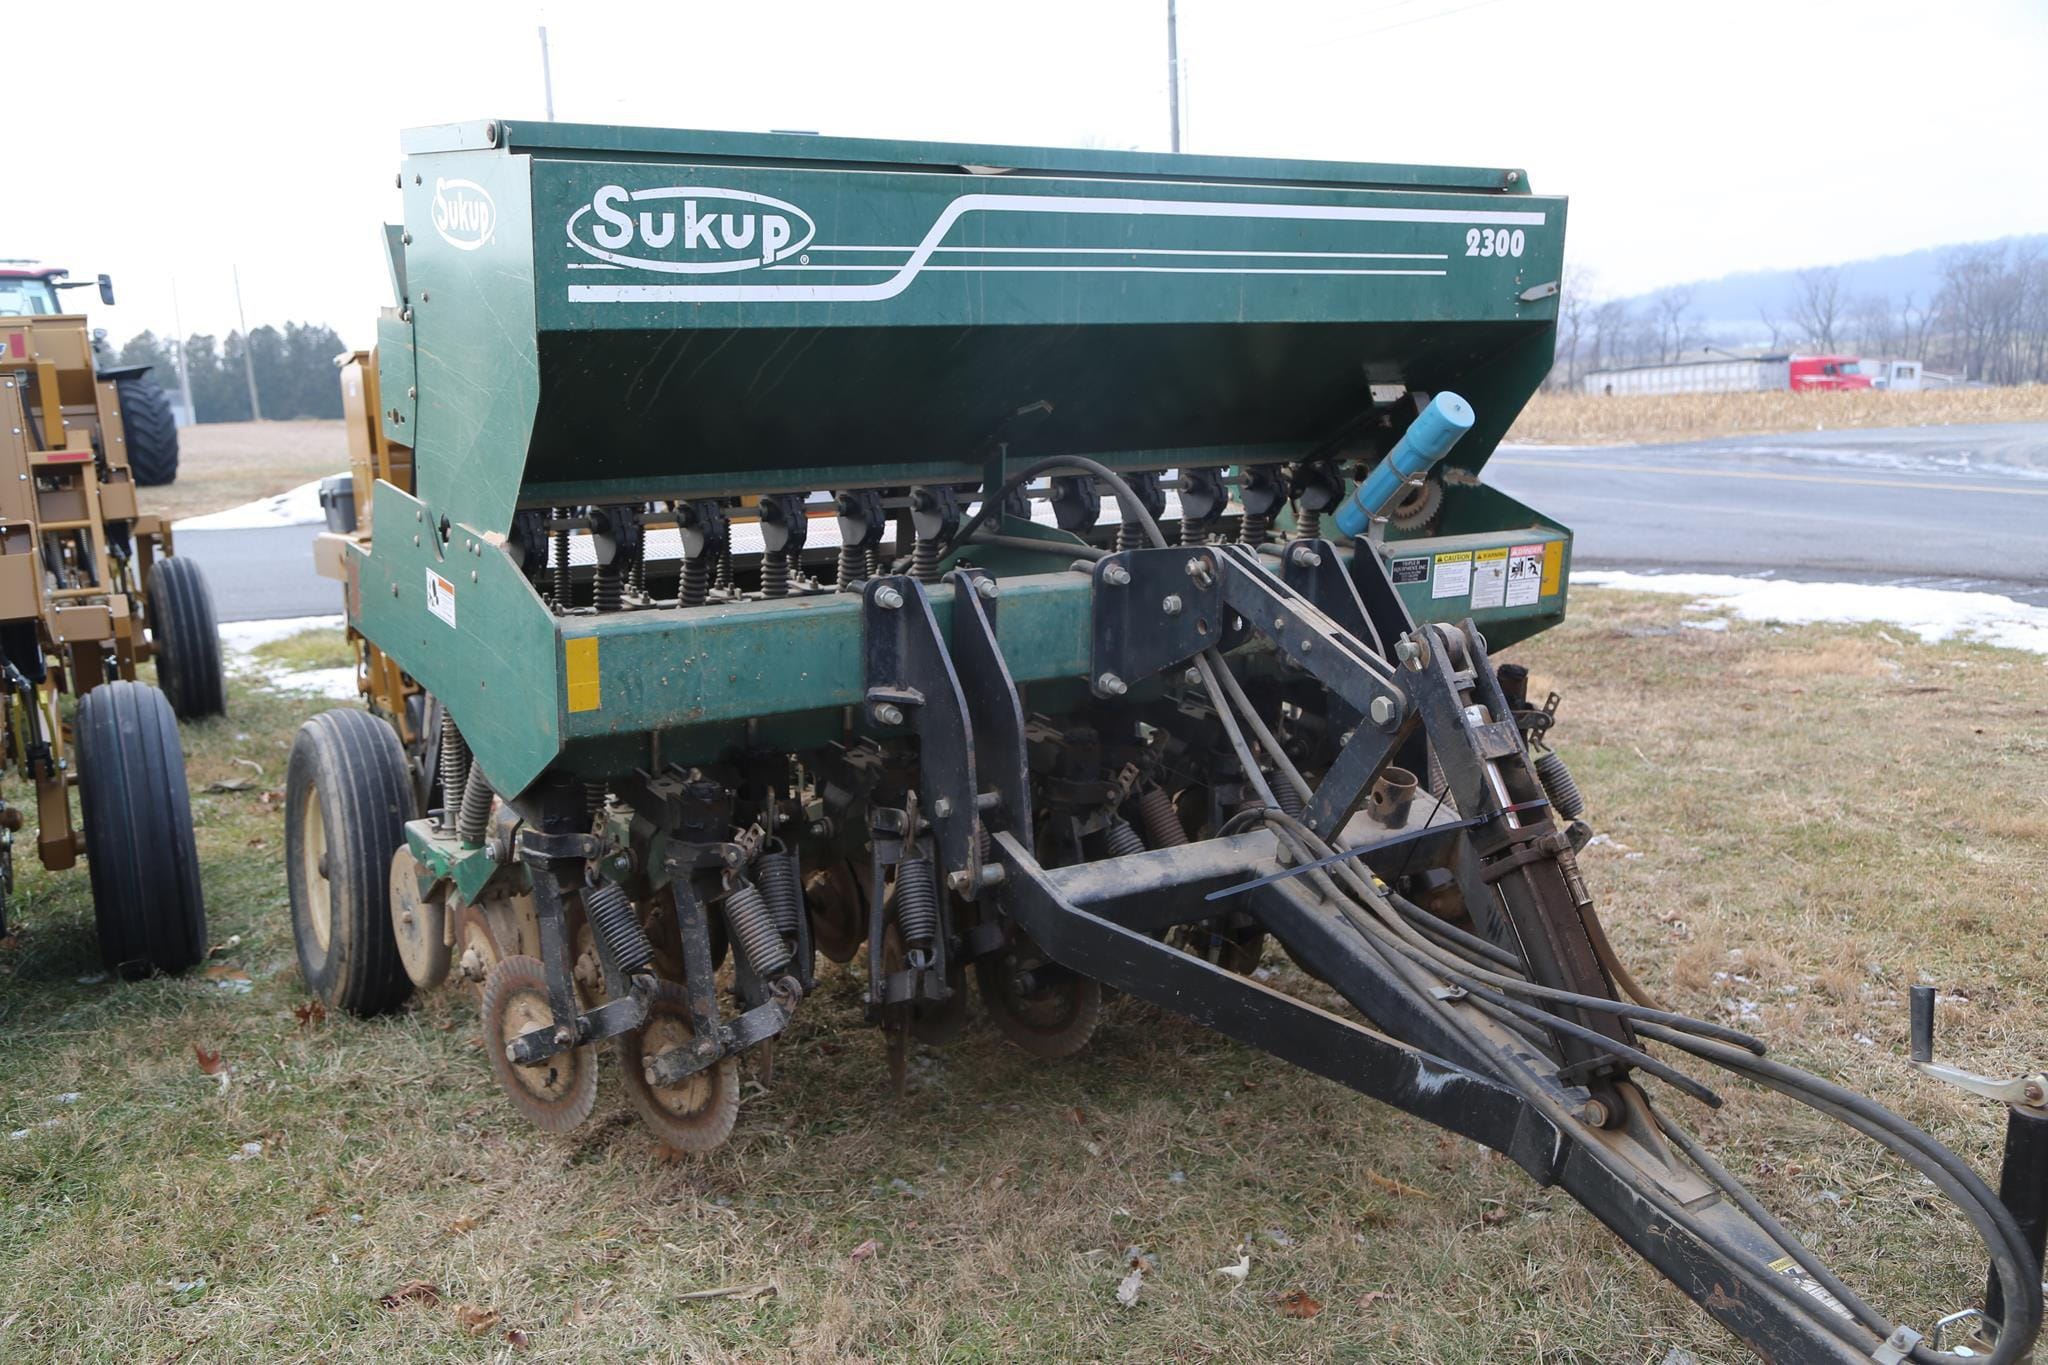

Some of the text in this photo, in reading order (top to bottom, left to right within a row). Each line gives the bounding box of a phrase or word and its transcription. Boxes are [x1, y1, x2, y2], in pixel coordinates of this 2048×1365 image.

[436, 177, 489, 245] Sukup
[592, 185, 791, 265] Sukup
[1465, 228, 1525, 257] 2300
[1443, 553, 1470, 563] CAUTION
